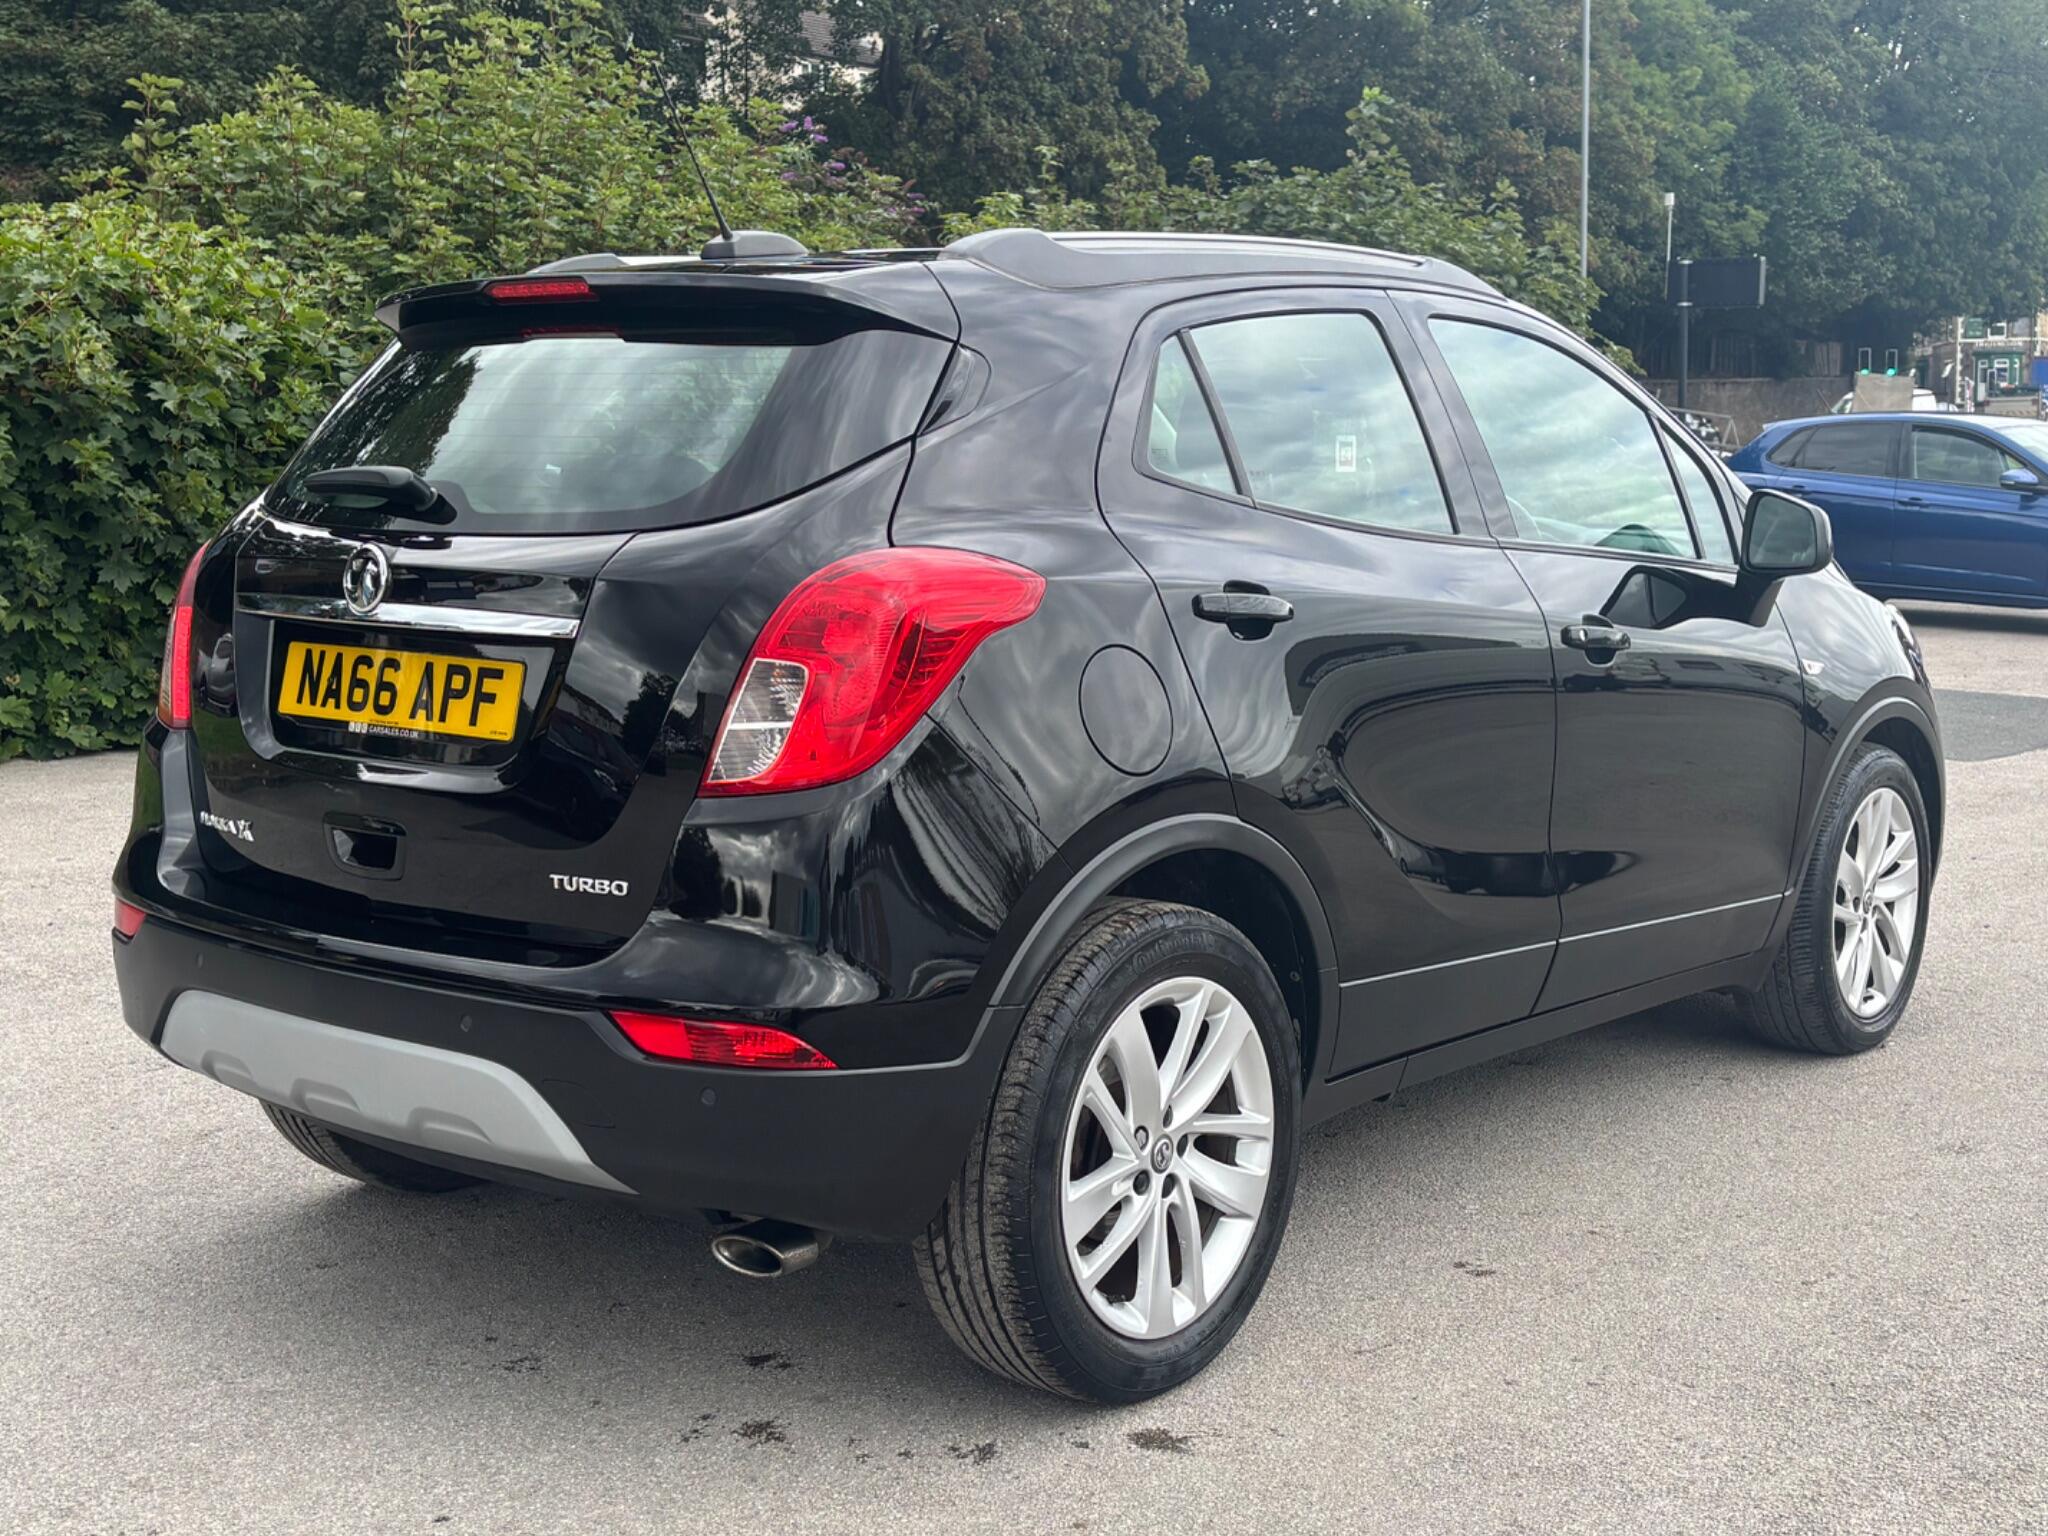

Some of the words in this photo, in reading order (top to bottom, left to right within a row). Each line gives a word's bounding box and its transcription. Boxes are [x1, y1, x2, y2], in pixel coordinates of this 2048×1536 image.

[296, 648, 401, 715] NA66
[409, 661, 505, 727] APF
[549, 873, 629, 897] TURBO
